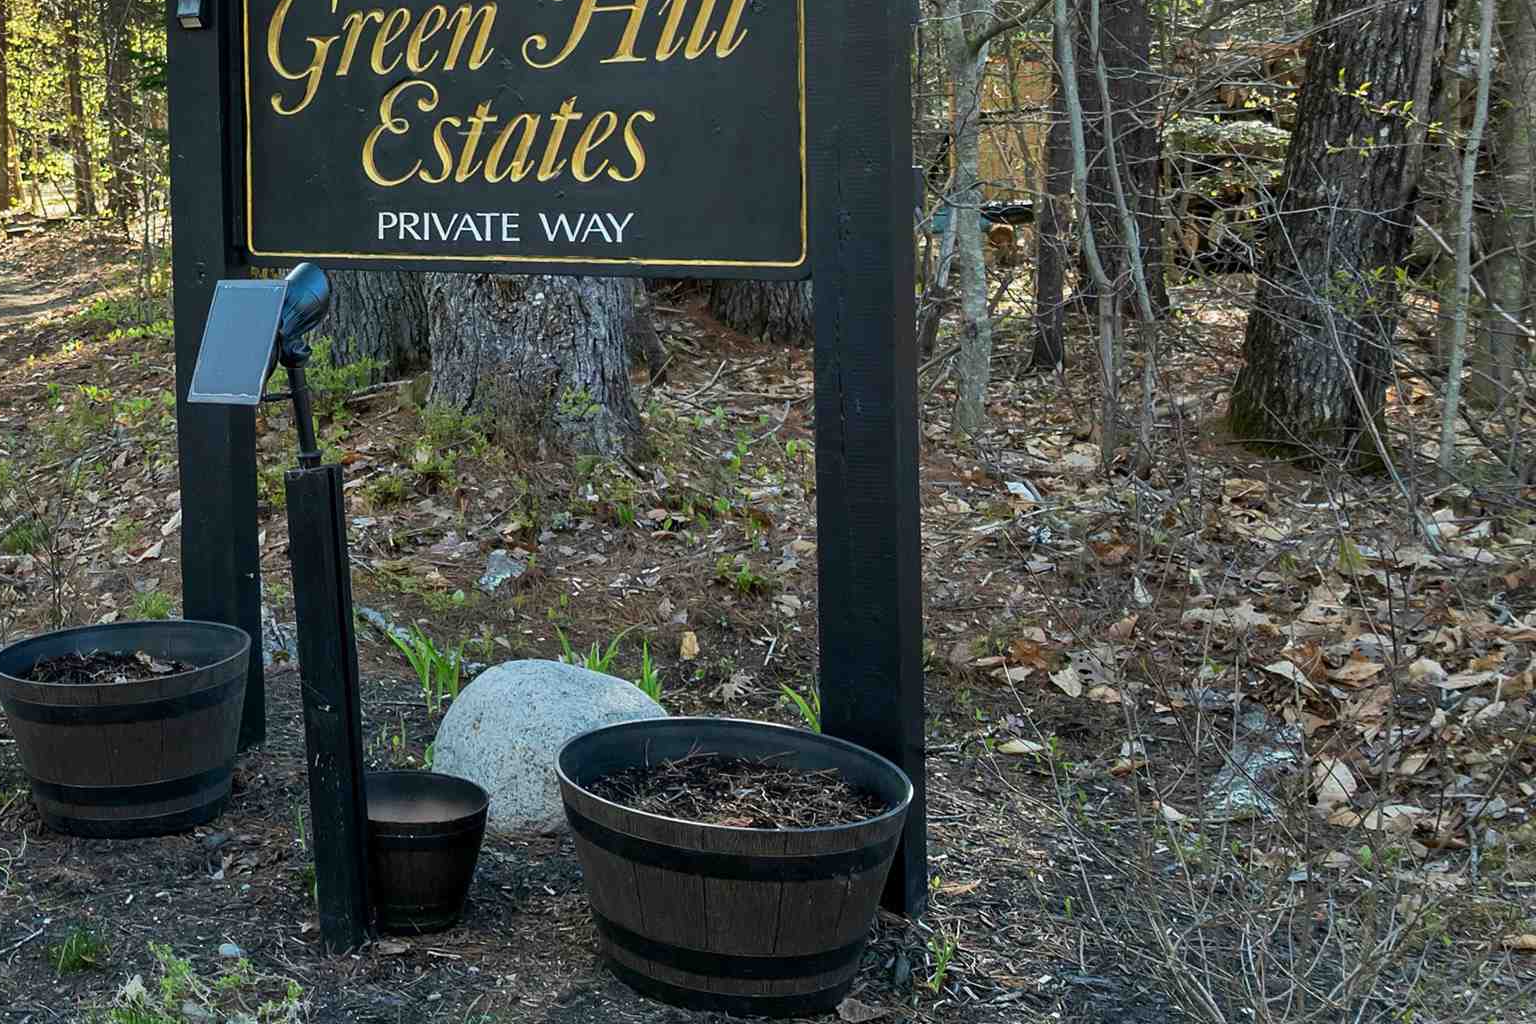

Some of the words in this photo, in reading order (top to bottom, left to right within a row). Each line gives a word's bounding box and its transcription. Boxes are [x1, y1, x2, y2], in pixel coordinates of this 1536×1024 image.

[362, 79, 657, 188] Estates
[376, 211, 521, 243] PRIVATE
[537, 211, 636, 244] WAY
